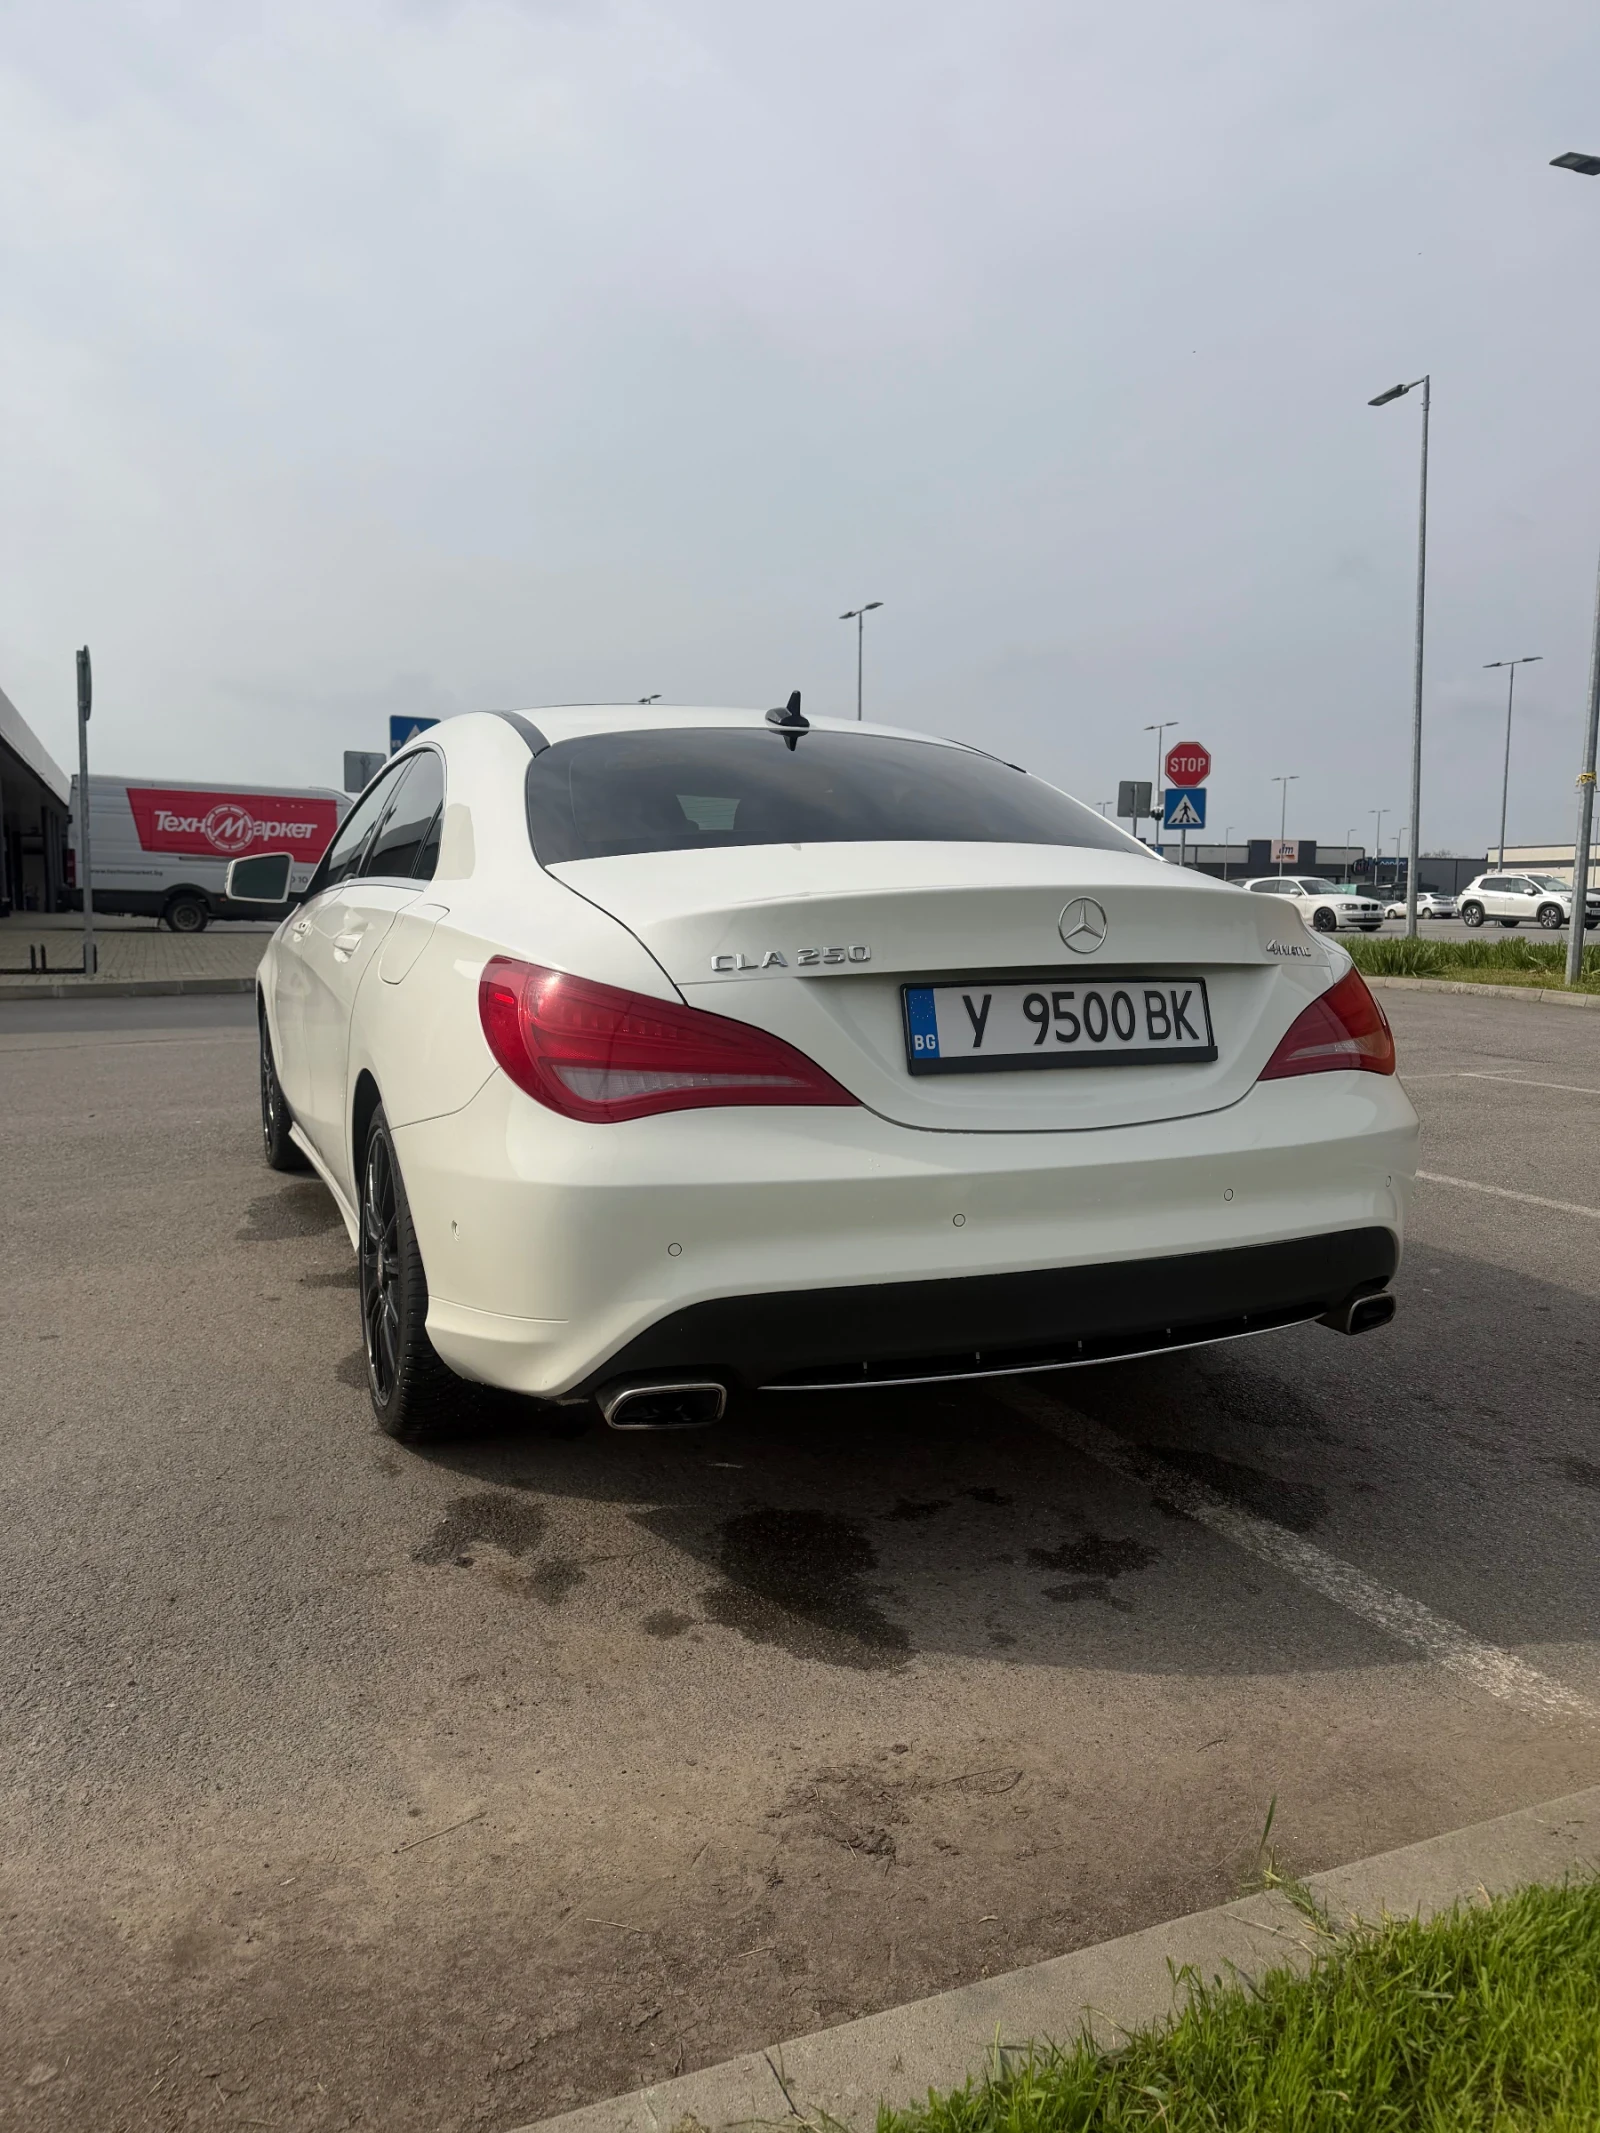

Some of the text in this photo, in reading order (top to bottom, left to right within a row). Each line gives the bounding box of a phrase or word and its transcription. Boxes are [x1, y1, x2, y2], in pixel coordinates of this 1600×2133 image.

[1170, 757, 1206, 773] STOP
[711, 945, 871, 971] CLA 250
[914, 1034, 936, 1051] BG
